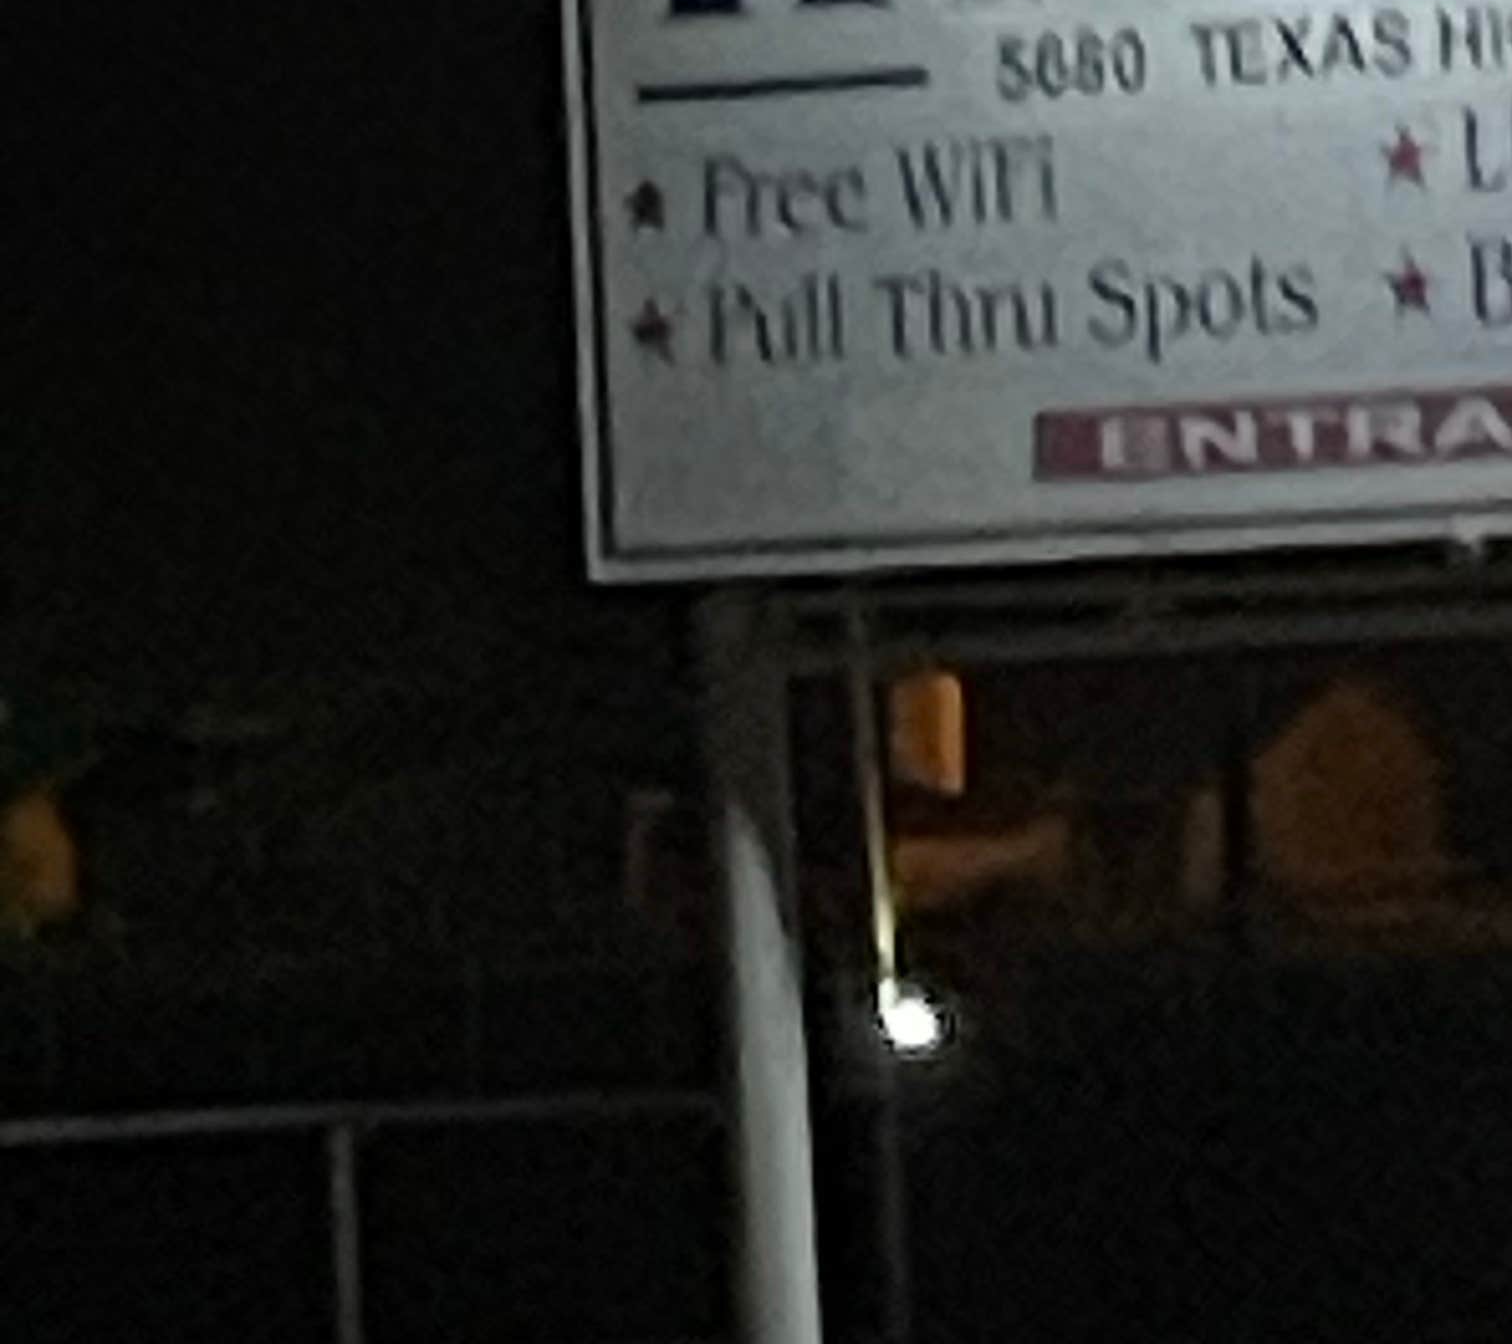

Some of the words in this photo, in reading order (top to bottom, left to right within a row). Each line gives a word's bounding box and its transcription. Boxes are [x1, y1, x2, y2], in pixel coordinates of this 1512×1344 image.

[1191, 7, 1412, 86] TEXAS
[703, 154, 869, 237] Free
[707, 269, 844, 365] Pull
[875, 269, 1059, 359] Thru
[1087, 255, 1320, 364] Spots
